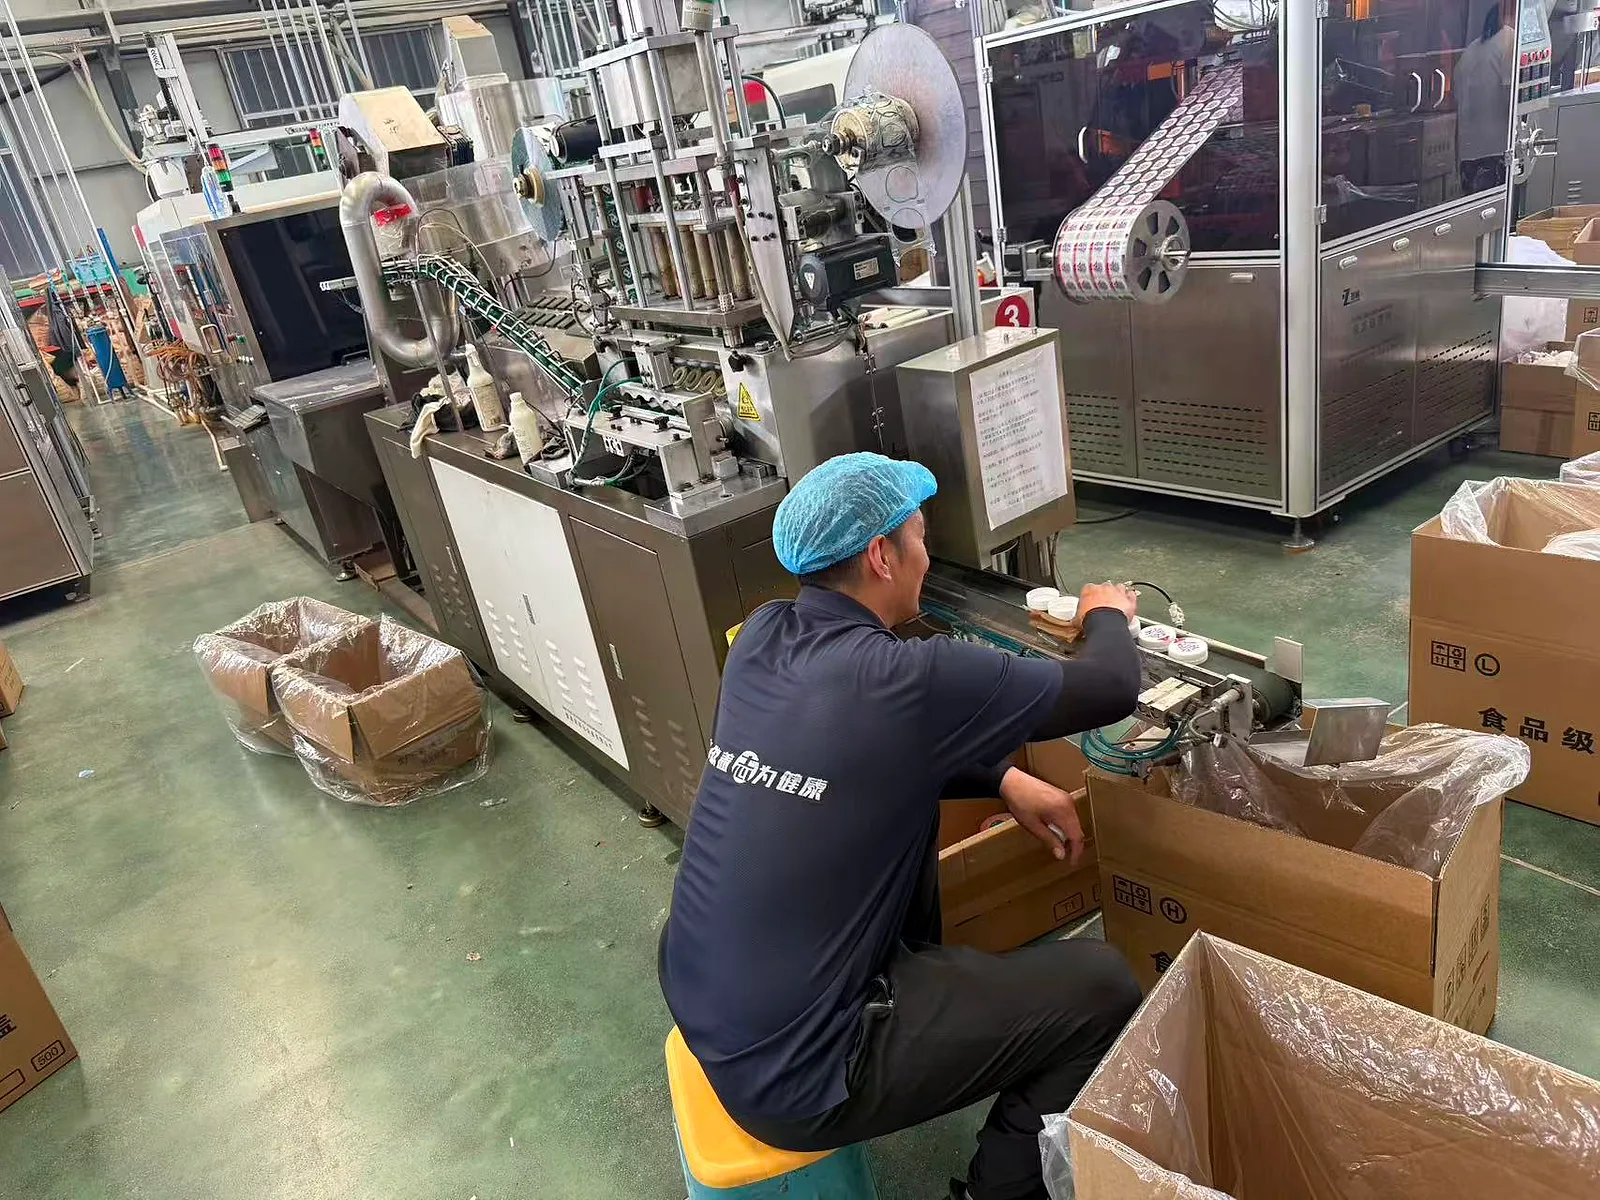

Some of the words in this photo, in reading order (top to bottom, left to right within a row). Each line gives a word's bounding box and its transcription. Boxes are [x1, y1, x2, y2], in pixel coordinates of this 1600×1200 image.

[1004, 304, 1020, 327] 3
[1478, 707, 1595, 755] 食品级
[38, 1046, 59, 1066] 500
